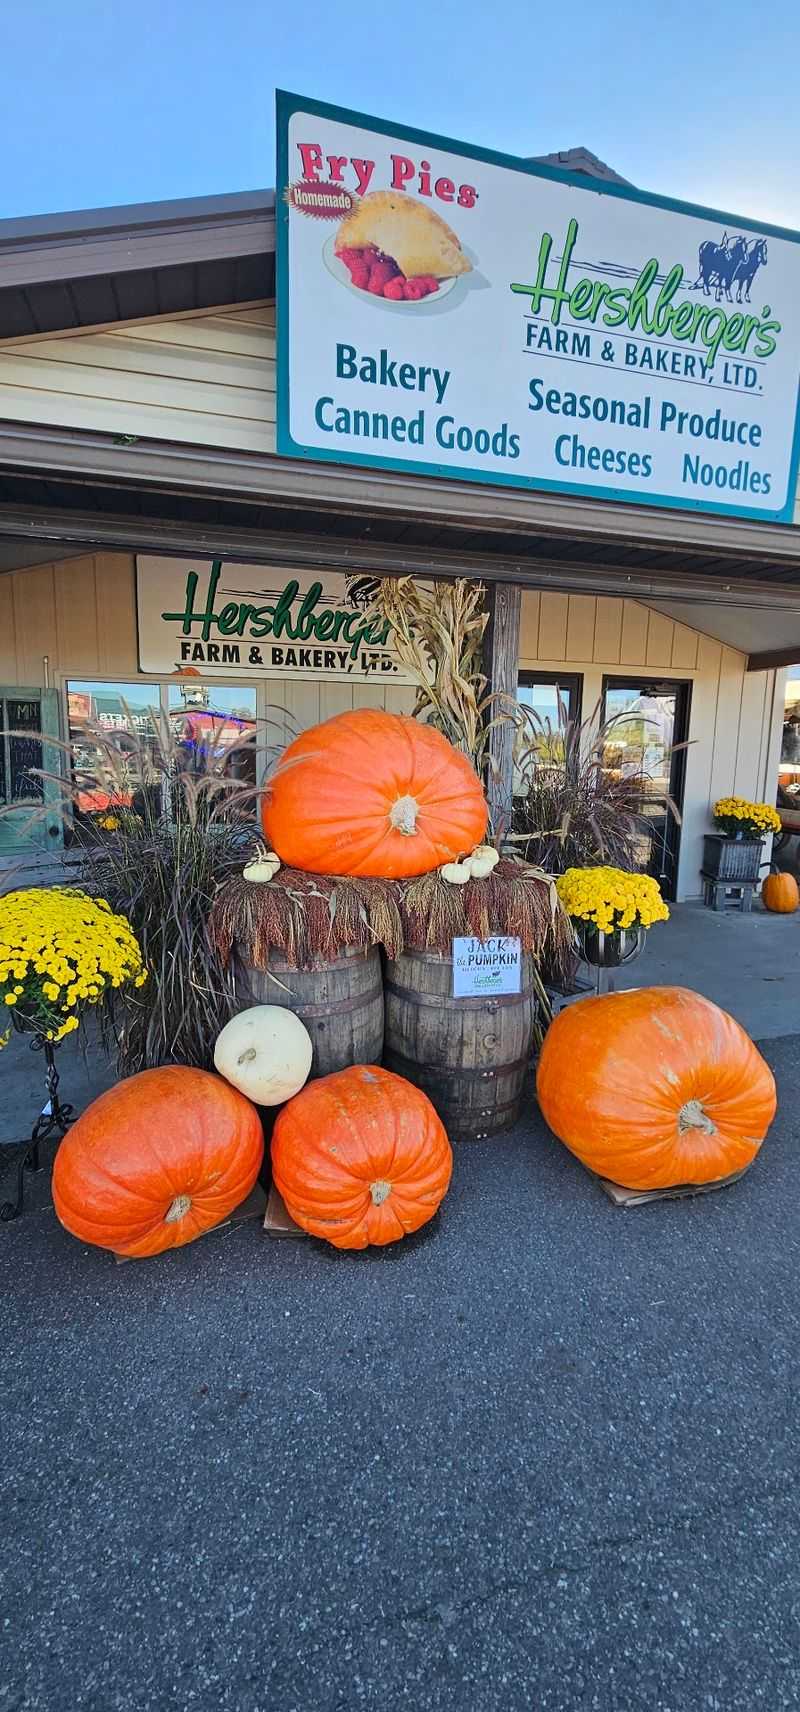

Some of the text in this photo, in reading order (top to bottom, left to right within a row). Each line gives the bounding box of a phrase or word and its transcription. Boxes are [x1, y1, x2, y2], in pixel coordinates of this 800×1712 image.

[293, 187, 353, 210] Homemade
[296, 143, 479, 209] Fry Pies
[510, 218, 782, 367] Hershberger's
[335, 343, 451, 404] Bakery
[526, 323, 764, 391] FARM & BAKERY, LTD.
[314, 397, 521, 459] Canned Goods
[528, 378, 762, 447] Seasonal Produce
[555, 434, 772, 494] Cheeses Noodles
[161, 560, 414, 660] Hershberger
[180, 641, 240, 664] FARM
[248, 646, 263, 665] &
[271, 647, 353, 673] BAKERY,
[468, 938, 507, 953] JACK
[468, 953, 518, 967] PUMPKIN
